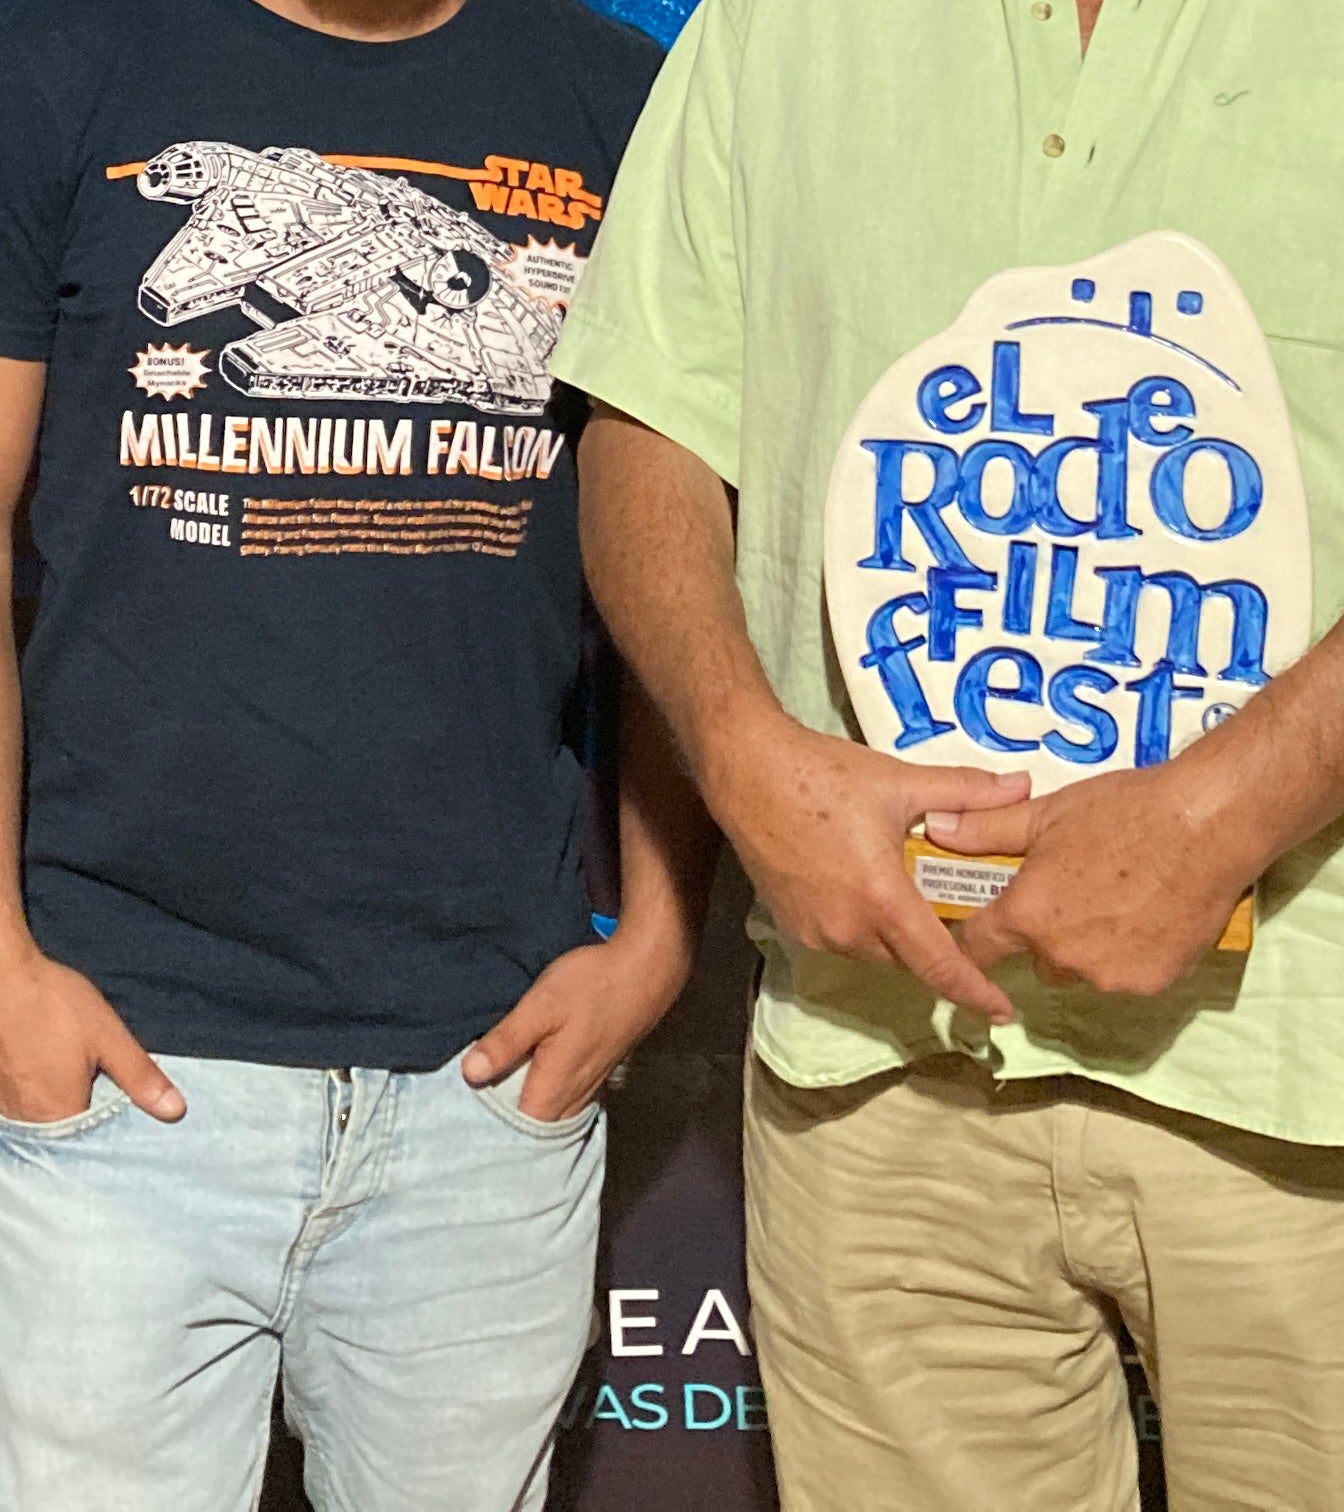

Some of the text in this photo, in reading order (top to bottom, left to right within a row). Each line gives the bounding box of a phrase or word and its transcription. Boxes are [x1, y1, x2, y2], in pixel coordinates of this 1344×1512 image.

[482, 154, 603, 208] STAR
[468, 182, 602, 230] WARS
[147, 357, 185, 366] BONUS!
[120, 410, 413, 476] MILLENNIUM
[129, 484, 173, 509] 1/72
[173, 489, 229, 516] SCALE
[170, 518, 231, 547] MODEL
